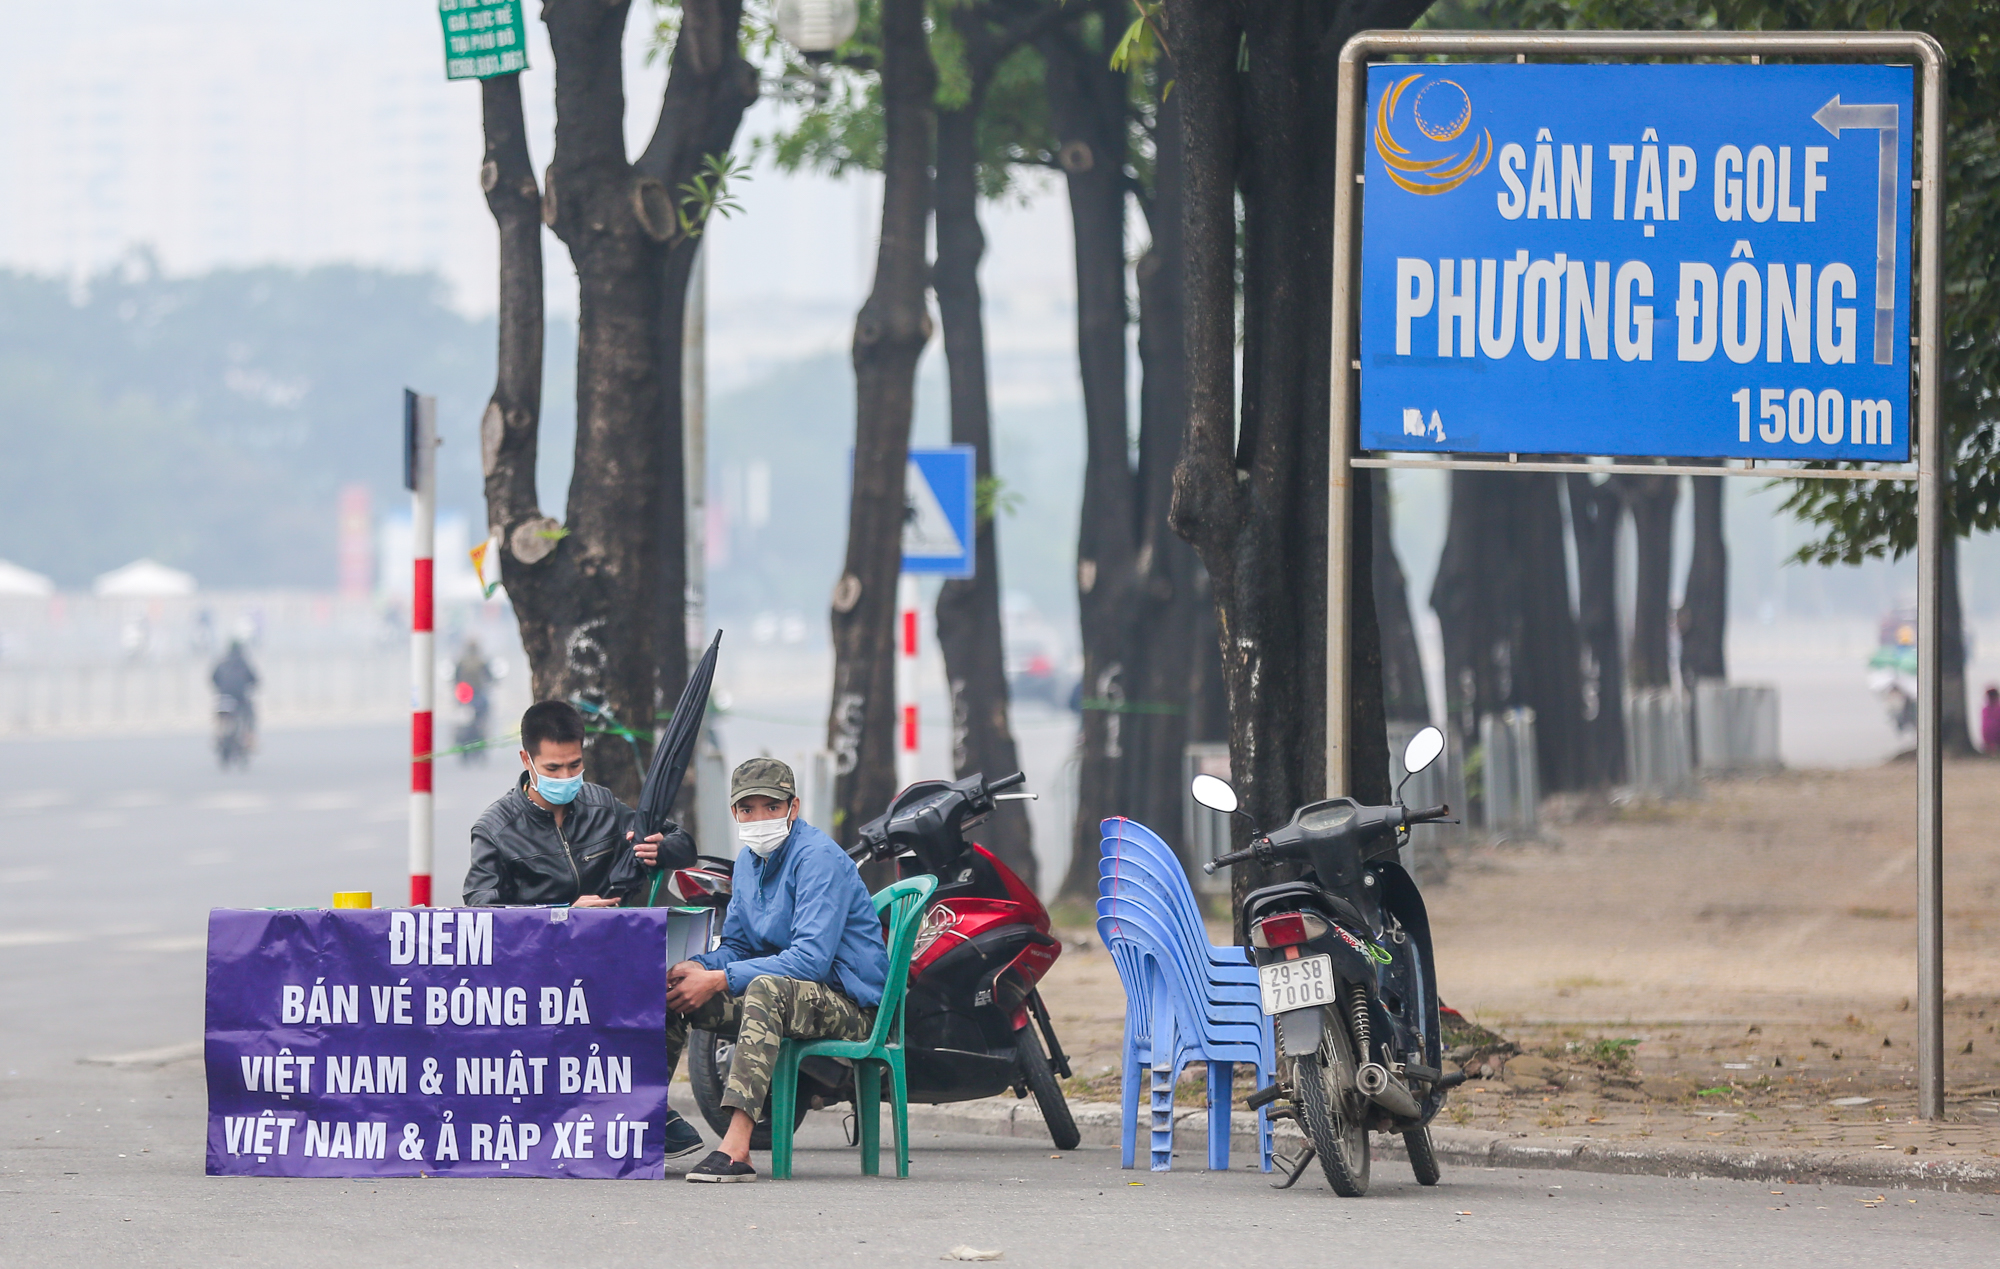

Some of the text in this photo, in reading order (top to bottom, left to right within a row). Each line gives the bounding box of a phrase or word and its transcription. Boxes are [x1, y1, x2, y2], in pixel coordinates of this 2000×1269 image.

[1498, 128, 1829, 237] SÂN TẬP GOLF
[1396, 240, 1857, 364] PHƯƠNG ĐÔNG
[282, 977, 590, 1026] BÁN VÉ BÓNG ĐÁ
[1272, 981, 1325, 1010] 7006
[241, 1043, 632, 1103] VIỆT NAM & NHẬT BẢN
[225, 1109, 650, 1169] VIỆT NAM & Ả RẬP XÊ ÚT
